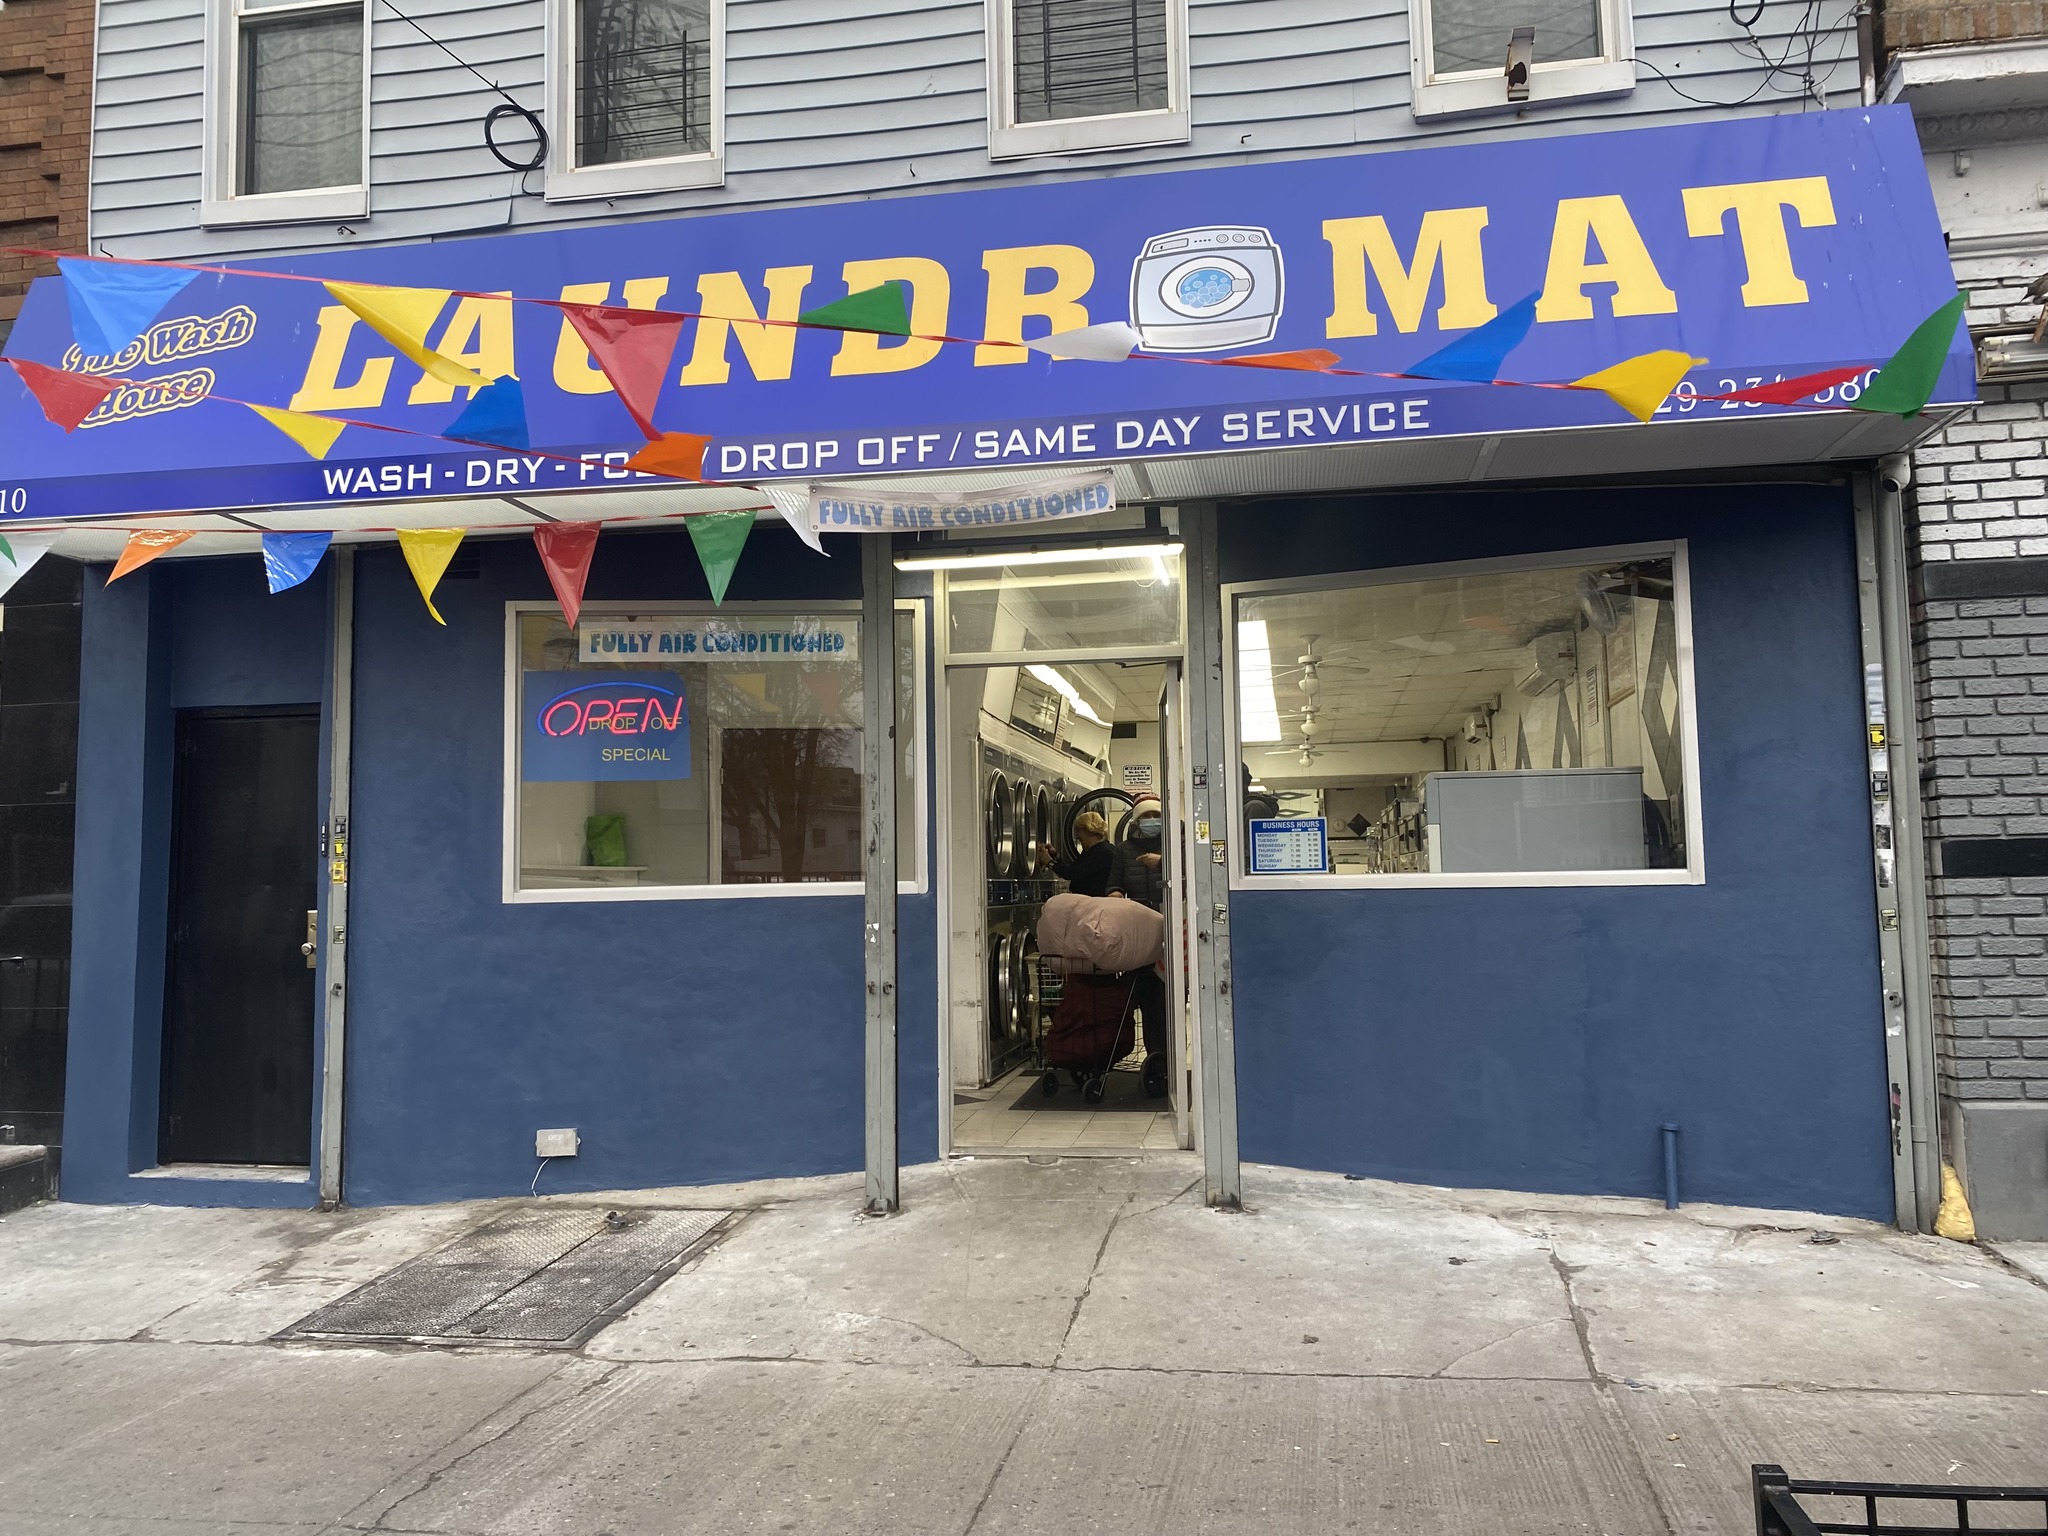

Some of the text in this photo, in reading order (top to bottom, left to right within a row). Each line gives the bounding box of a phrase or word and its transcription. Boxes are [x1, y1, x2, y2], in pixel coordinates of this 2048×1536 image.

[148, 307, 255, 362] Wash
[82, 370, 213, 425] House
[323, 464, 432, 495] WASH
[466, 457, 546, 487] DRY
[580, 451, 657, 480] FO
[721, 440, 839, 473] DROP
[858, 434, 941, 466] OFF
[974, 423, 1096, 459] SAME
[1116, 416, 1200, 450] DAY
[1222, 400, 1430, 442] SERVICE
[819, 483, 1109, 528] FULLY AIR CONDITIONED
[590, 630, 845, 653] FULLY AIR CONDITIONED
[544, 696, 683, 736] OPEN
[589, 716, 683, 730] DROP OFF
[602, 748, 671, 762] SPECIAL
[1262, 820, 1320, 829] BUSINESS HOURS
